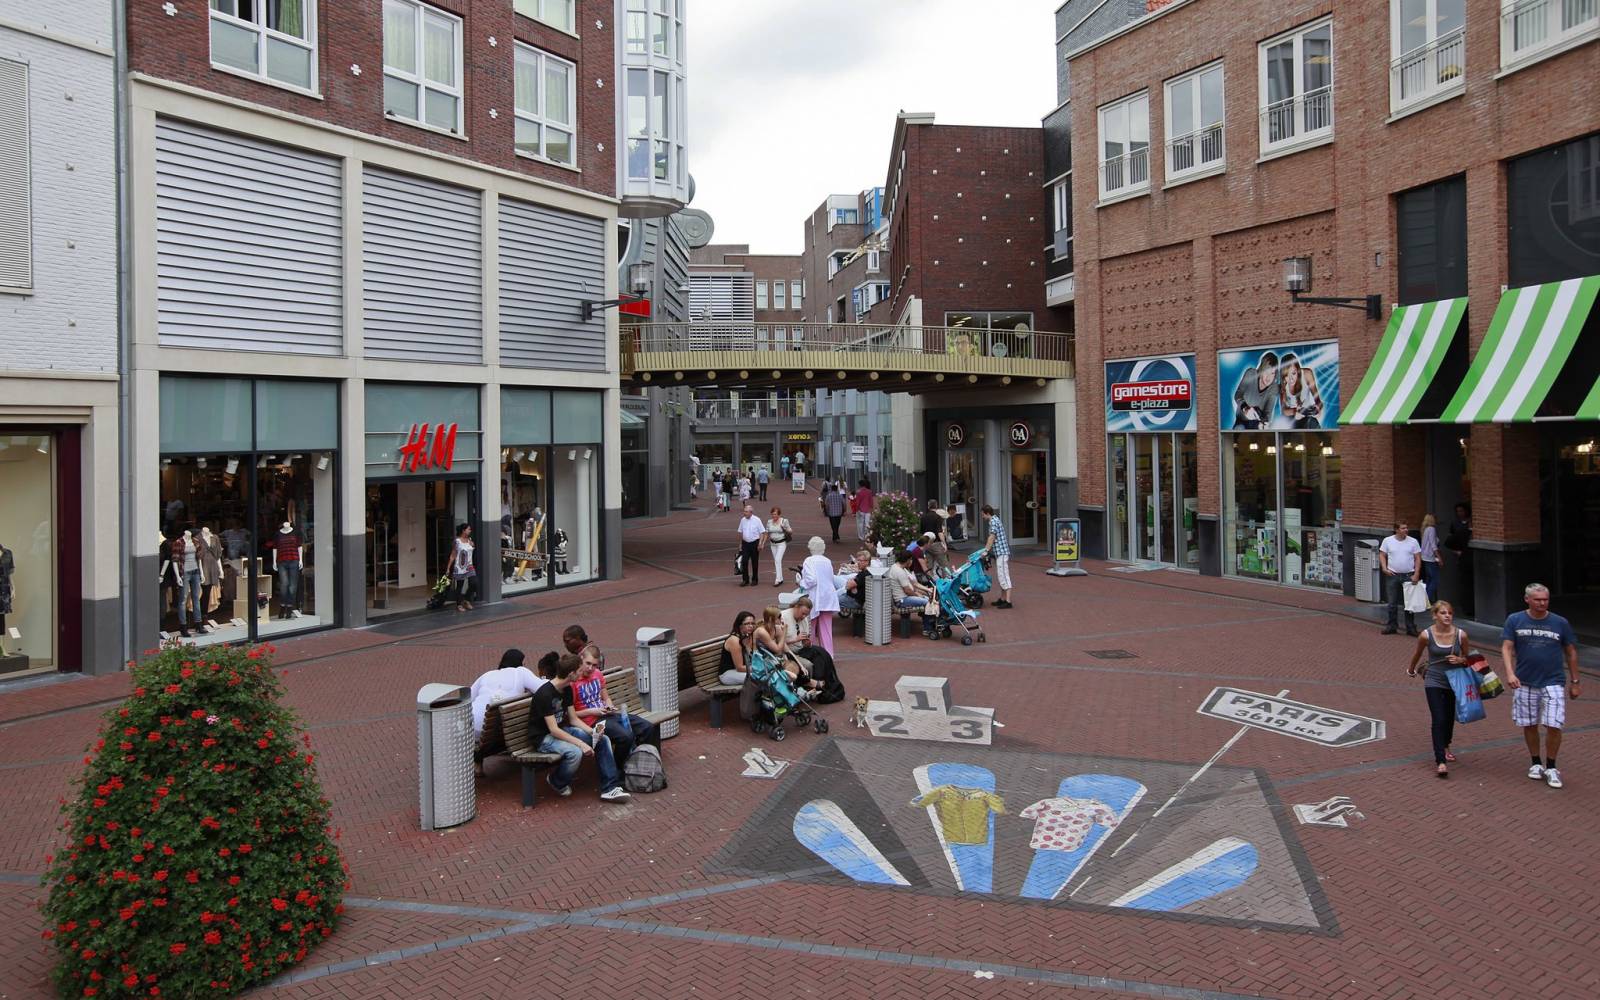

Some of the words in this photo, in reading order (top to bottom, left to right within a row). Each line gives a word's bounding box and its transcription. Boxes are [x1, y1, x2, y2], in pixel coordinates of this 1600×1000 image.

[1114, 383, 1188, 401] gamestore
[1130, 398, 1169, 412] e-plaza
[399, 423, 458, 473] H&M
[504, 551, 518, 559] BACK
[518, 552, 525, 560] TO
[525, 553, 543, 561] SCHOOL
[908, 690, 938, 711] 1
[1230, 695, 1344, 729] PARIS
[873, 714, 909, 735] 2
[950, 719, 984, 740] 3
[1234, 709, 1290, 728] 3619
[1294, 725, 1324, 737] KM
